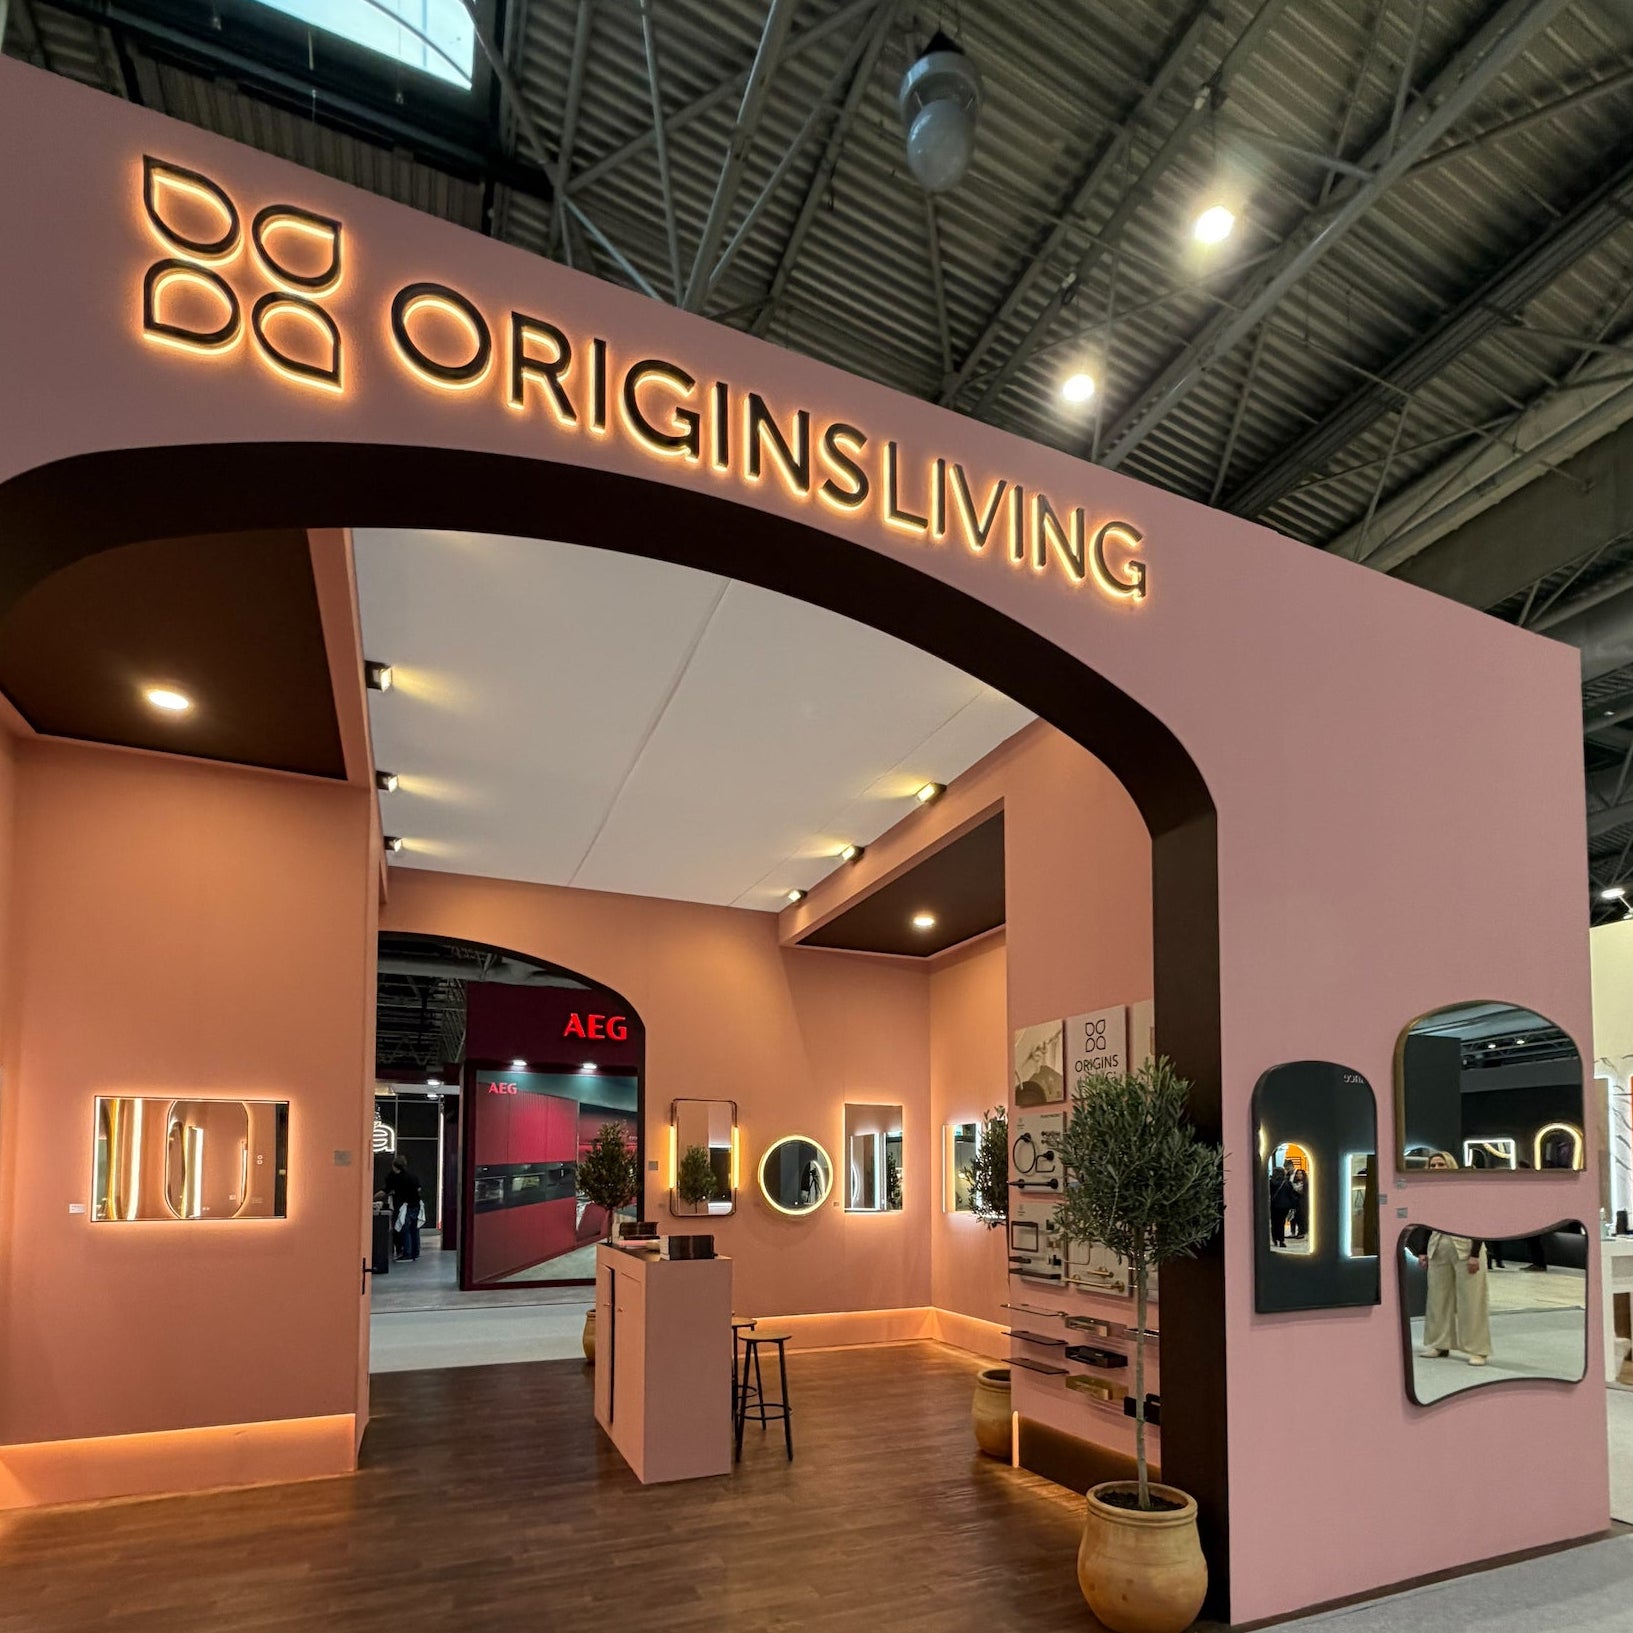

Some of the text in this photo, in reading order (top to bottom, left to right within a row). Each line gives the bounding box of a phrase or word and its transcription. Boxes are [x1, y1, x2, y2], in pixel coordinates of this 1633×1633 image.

[563, 1012, 628, 1041] AEG
[1074, 1054, 1120, 1073] ORIGINS
[488, 1082, 518, 1095] AEG
